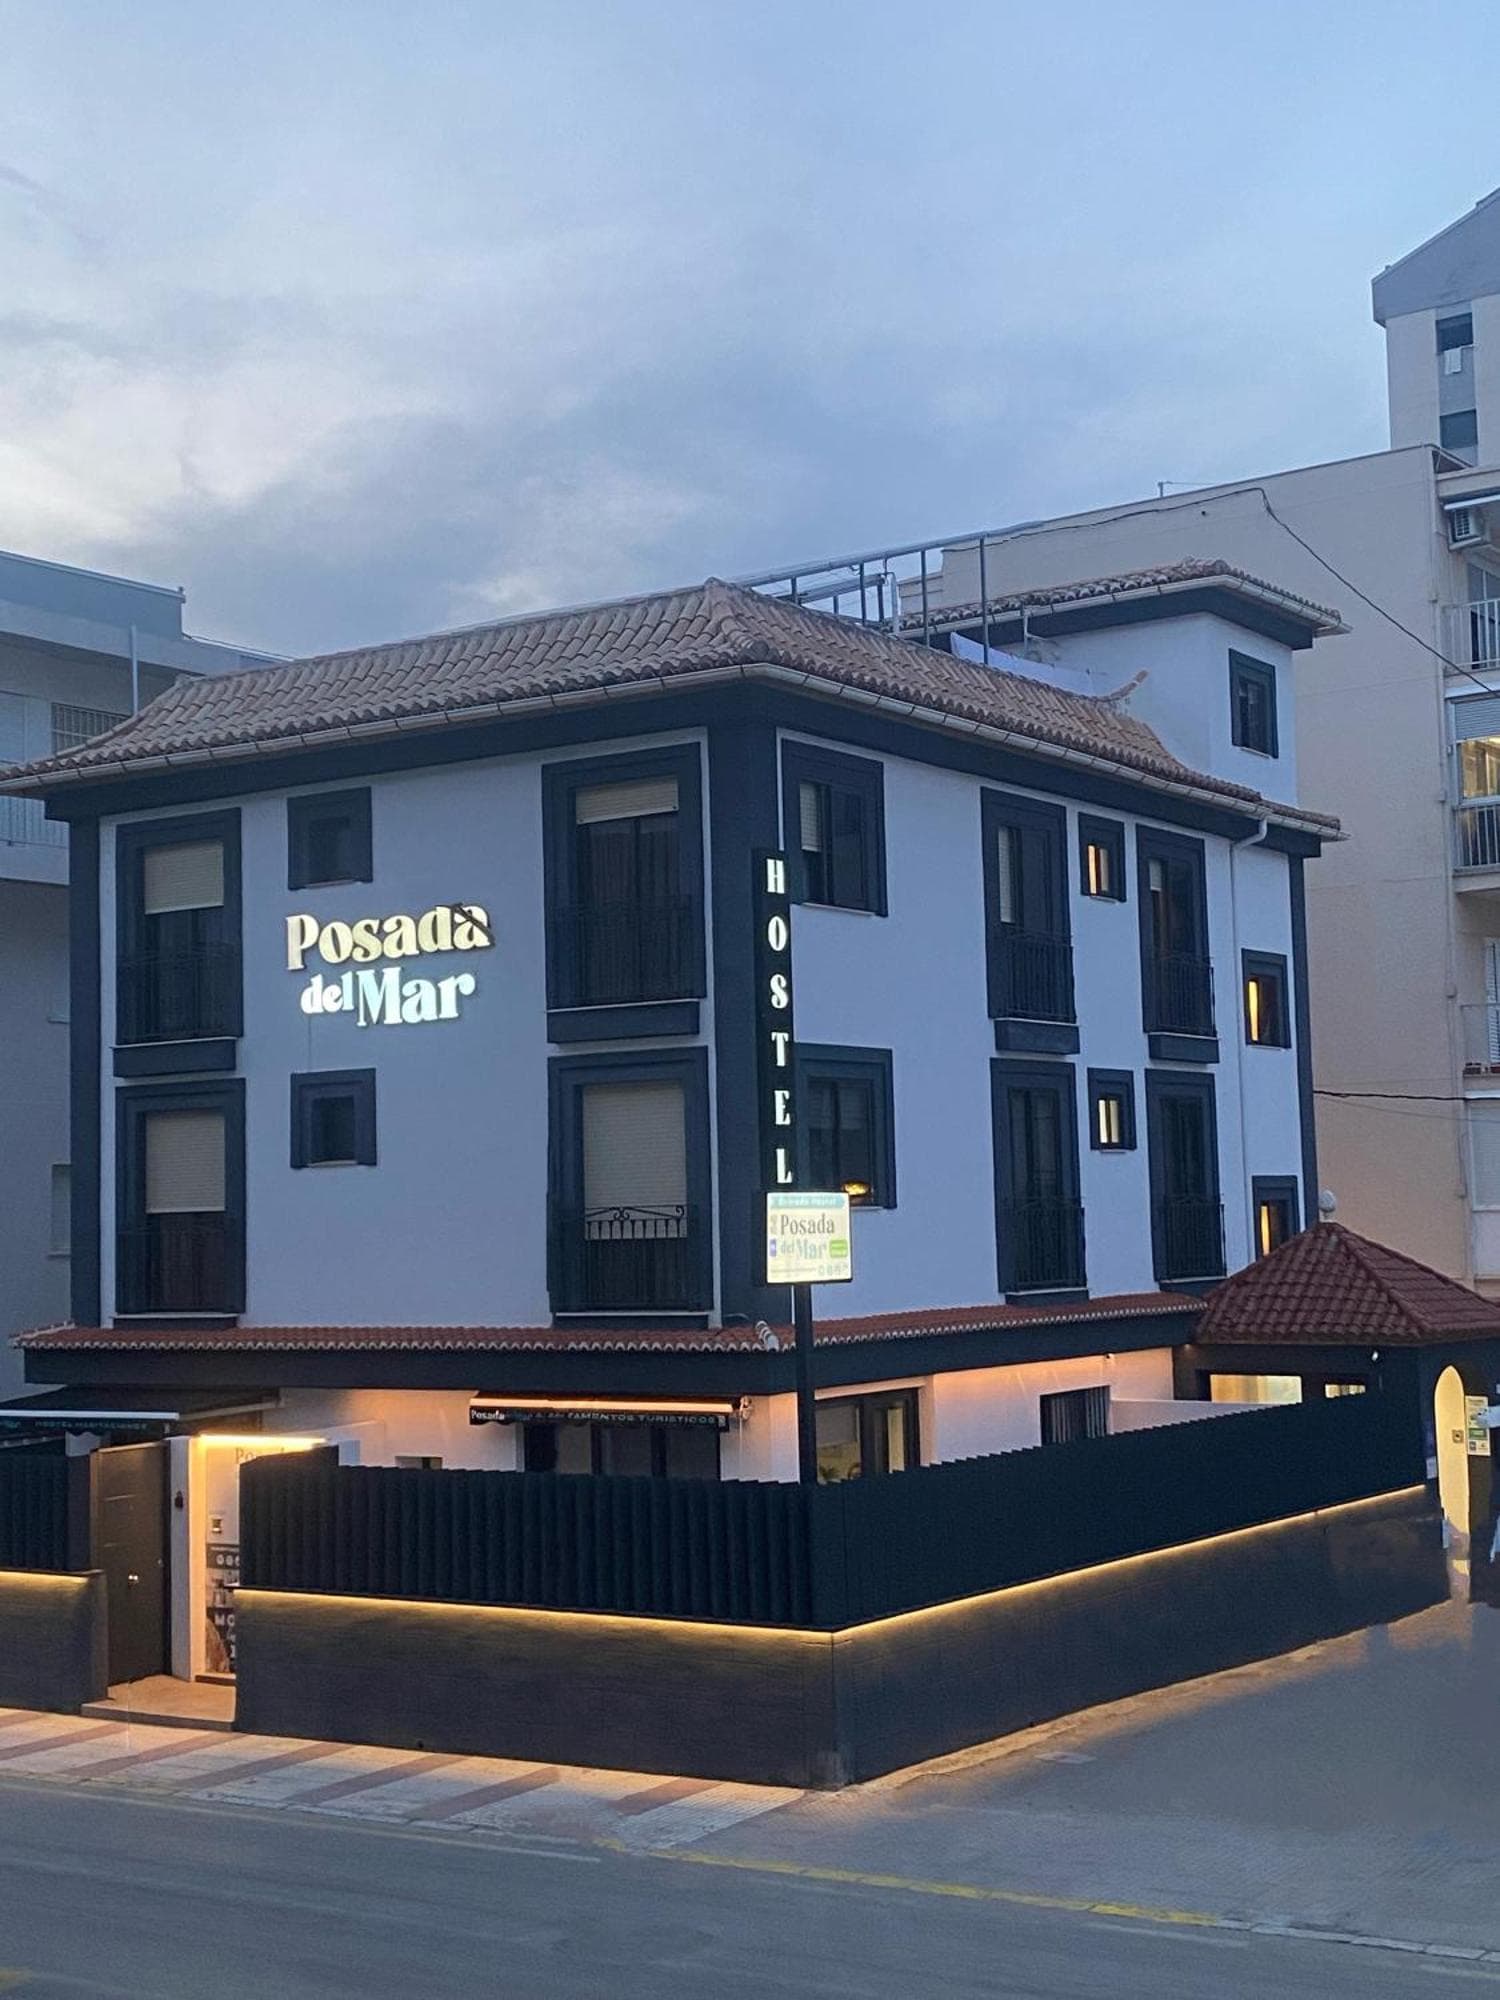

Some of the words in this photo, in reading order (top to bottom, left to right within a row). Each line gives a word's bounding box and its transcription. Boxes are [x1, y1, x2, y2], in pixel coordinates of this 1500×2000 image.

[286, 905, 492, 971] Posada
[301, 972, 355, 1015] del
[356, 967, 476, 1028] Mar
[766, 858, 793, 1184] HOSTEL
[780, 1212, 835, 1236] Posada
[471, 1409, 505, 1420] Posada
